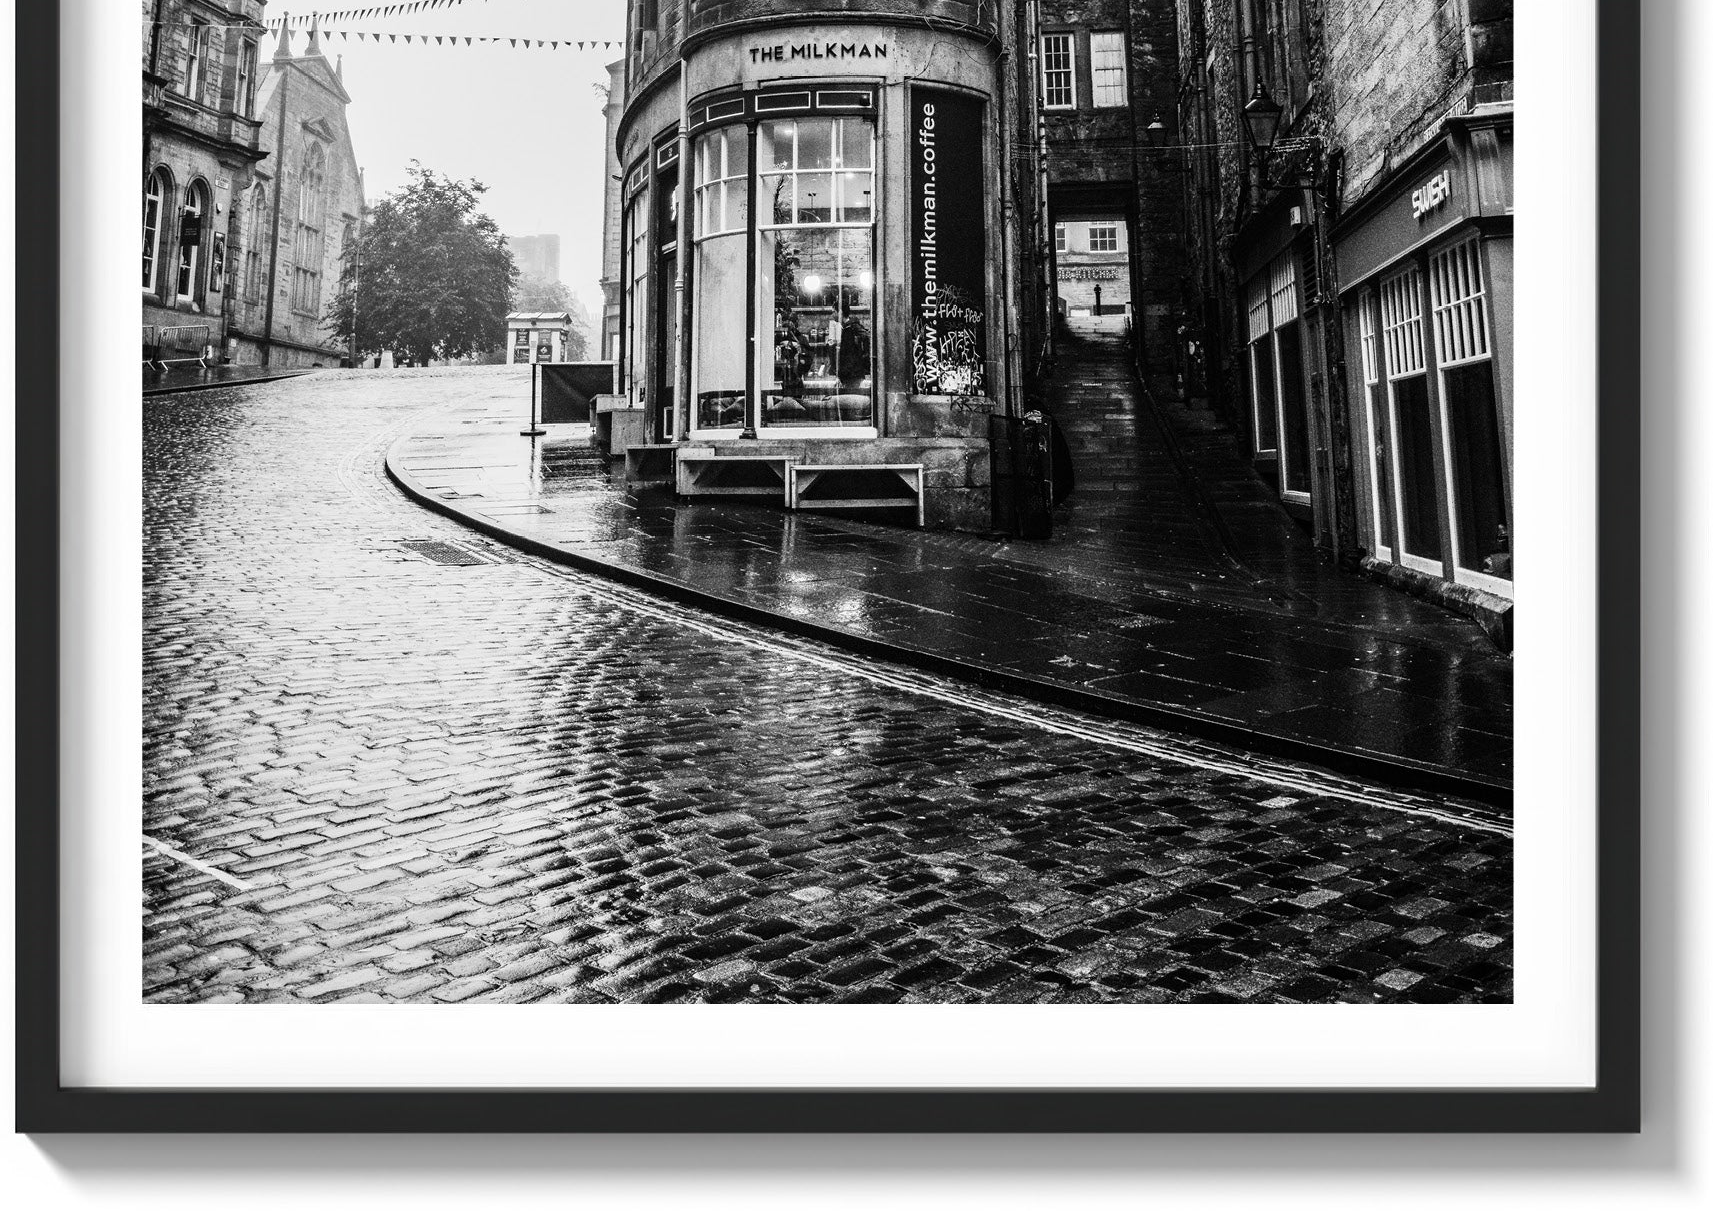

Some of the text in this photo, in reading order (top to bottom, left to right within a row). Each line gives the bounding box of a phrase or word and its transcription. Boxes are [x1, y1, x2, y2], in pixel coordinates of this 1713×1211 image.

[749, 43, 887, 63] THE MILKMAN
[1411, 170, 1450, 219] SWISH
[919, 103, 937, 383] www.themilkman.coffee
